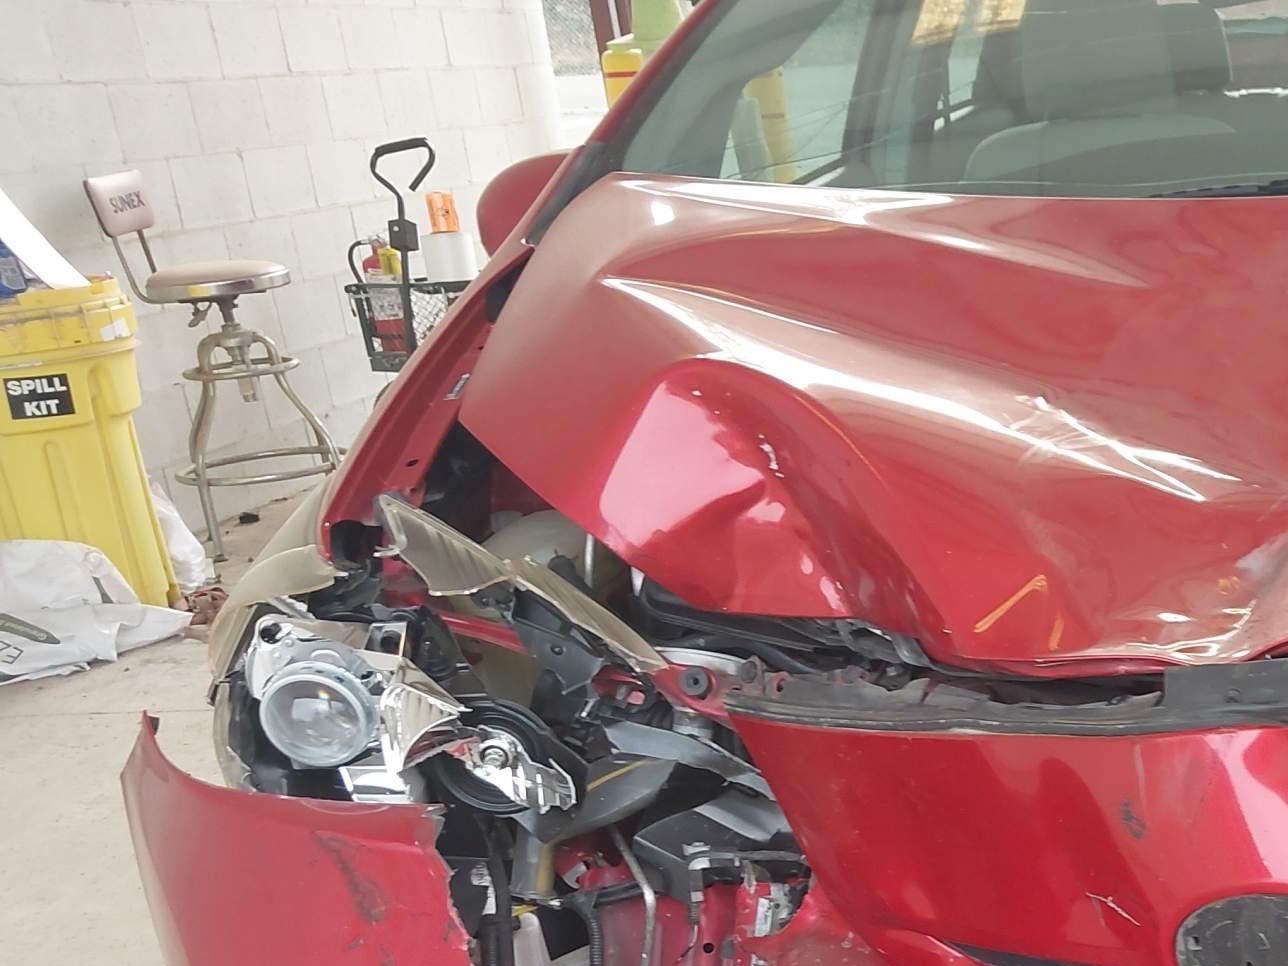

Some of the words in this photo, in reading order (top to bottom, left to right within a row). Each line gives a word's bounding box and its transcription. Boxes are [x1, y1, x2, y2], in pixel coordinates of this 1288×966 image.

[109, 191, 145, 213] SUNEX
[7, 377, 67, 396] SPILL
[23, 399, 60, 416] KIT
